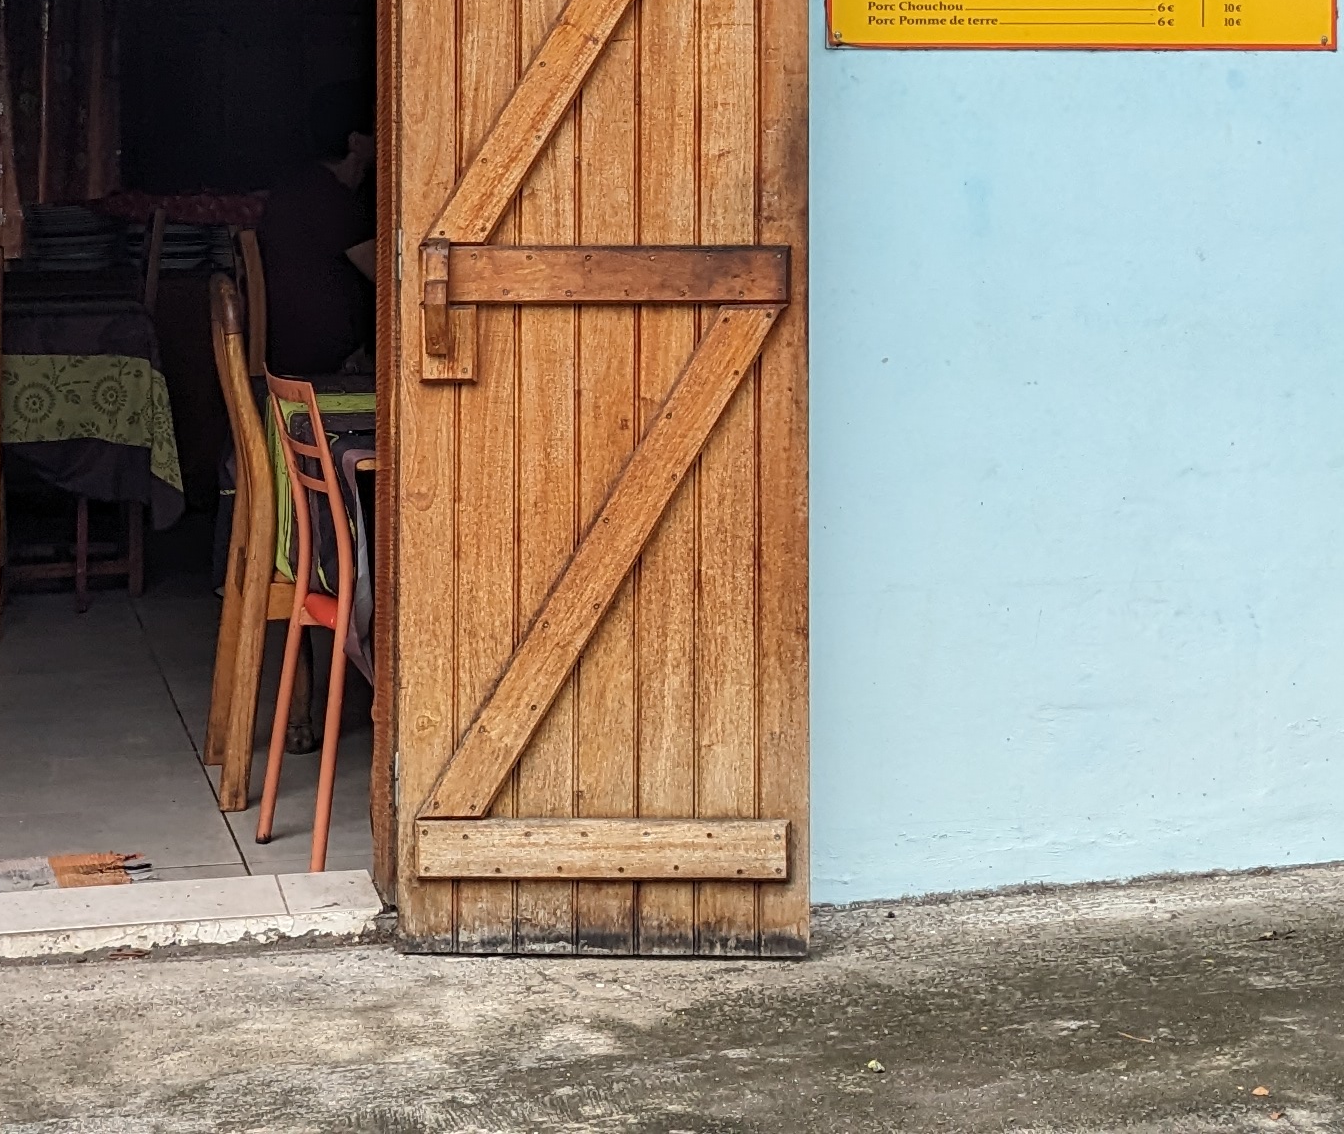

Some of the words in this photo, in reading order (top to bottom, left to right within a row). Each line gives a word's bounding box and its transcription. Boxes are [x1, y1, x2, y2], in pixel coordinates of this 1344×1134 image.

[868, 2, 895, 10] Porc
[899, 1, 963, 11] Chouchou
[868, 16, 895, 25] Porc
[900, 16, 946, 25] Pomme
[950, 16, 964, 25] de
[968, 17, 998, 25] terre
